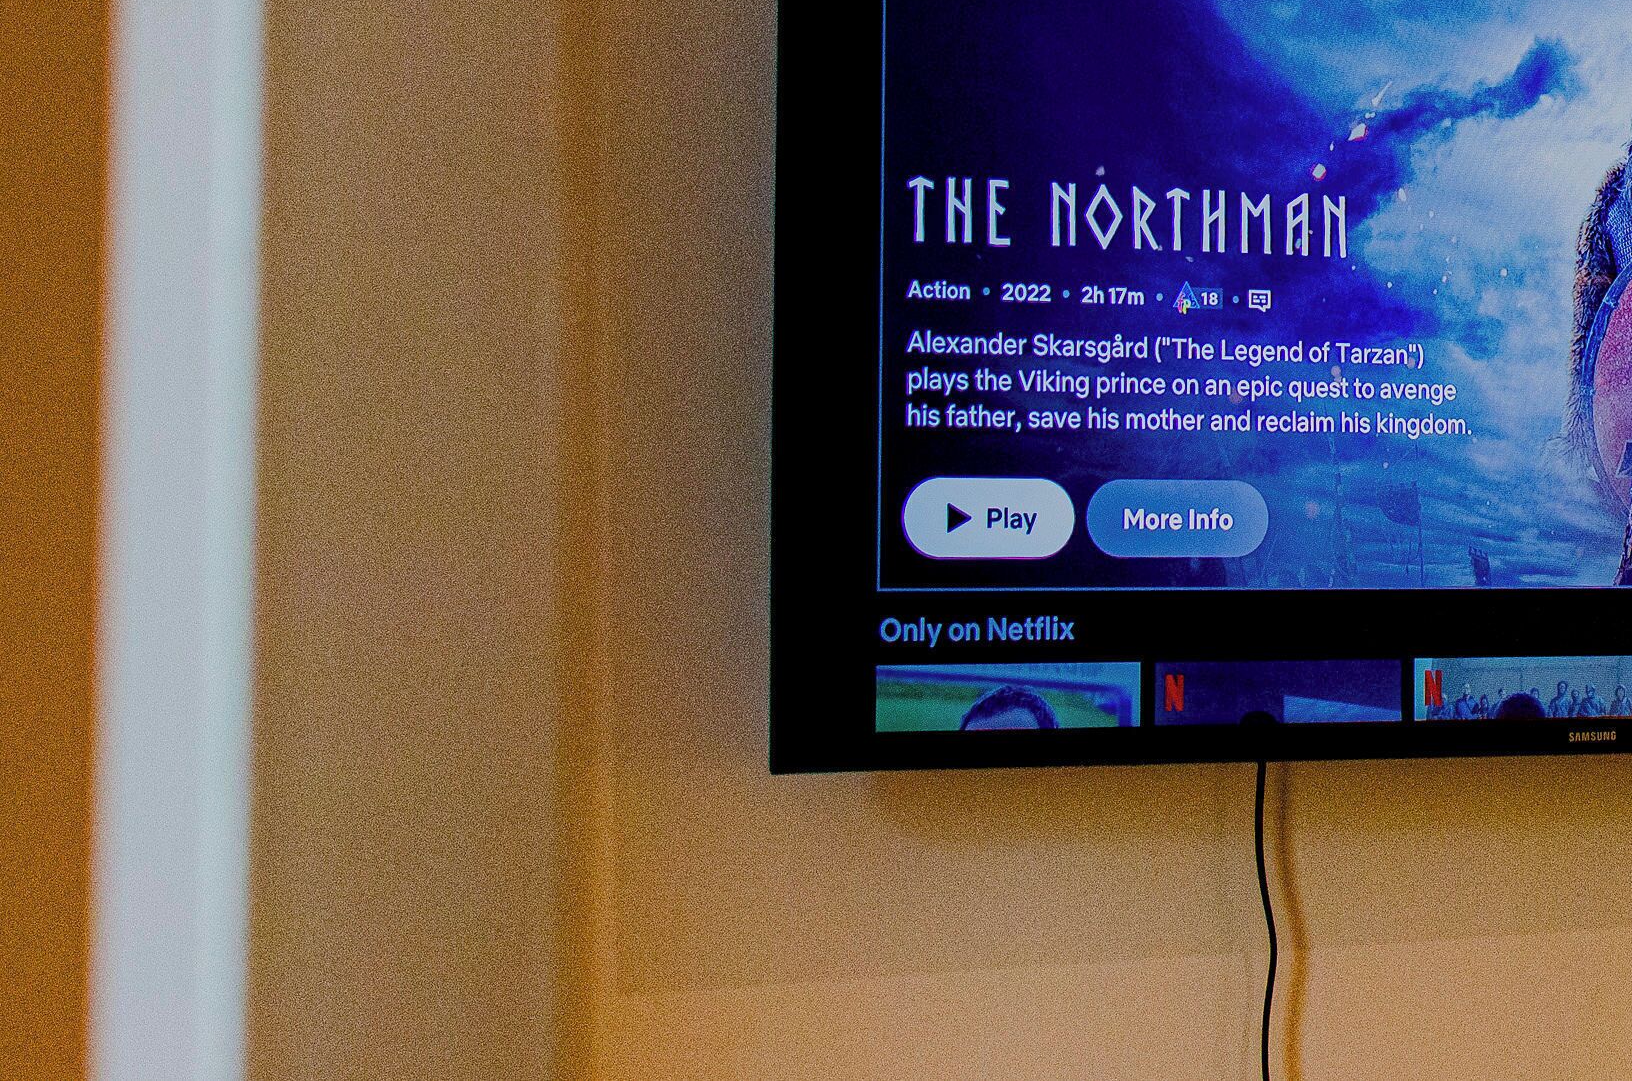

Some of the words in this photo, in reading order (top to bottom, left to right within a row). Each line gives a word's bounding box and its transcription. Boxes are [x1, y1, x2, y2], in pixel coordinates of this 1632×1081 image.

[907, 176, 1011, 247] THE
[1051, 181, 1347, 258] NORTHMAN
[907, 280, 971, 301] Action
[1002, 283, 1052, 303] 2022
[1082, 285, 1106, 305] 2h
[1108, 287, 1145, 306] 17m
[1201, 292, 1219, 306] 18
[906, 330, 1027, 356] Alexander
[1033, 333, 1149, 364] Skarsgård
[1154, 336, 1214, 363] ("The
[1221, 339, 1303, 367] Legend
[1309, 342, 1331, 363] of
[1335, 342, 1424, 369] Tarzan")
[906, 366, 969, 396] plays
[975, 368, 1012, 391] the
[1018, 370, 1090, 399] Viking
[1097, 372, 1166, 399] prince
[1172, 377, 1199, 396] on
[1205, 379, 1231, 396] an
[1237, 376, 1283, 401] epic
[1288, 378, 1349, 403] quest
[1353, 378, 1375, 400] to
[1380, 383, 1457, 406] avenge
[906, 403, 941, 427] his
[946, 404, 1022, 433] father,
[1028, 411, 1081, 429] save
[1087, 406, 1120, 430] his
[1125, 407, 1204, 431] mother
[1210, 410, 1251, 432] and
[1257, 411, 1335, 433] reclaim
[1341, 412, 1371, 434] his
[1376, 412, 1473, 440] kingdom.
[986, 507, 1038, 535] Play
[1123, 509, 1183, 531] More
[1188, 508, 1234, 531] Info
[880, 617, 942, 648] Only
[948, 622, 980, 642] on
[987, 616, 1075, 642] Netflix
[1165, 674, 1184, 712] N
[1425, 670, 1443, 707] N
[1568, 730, 1617, 743] SAMSUNG
